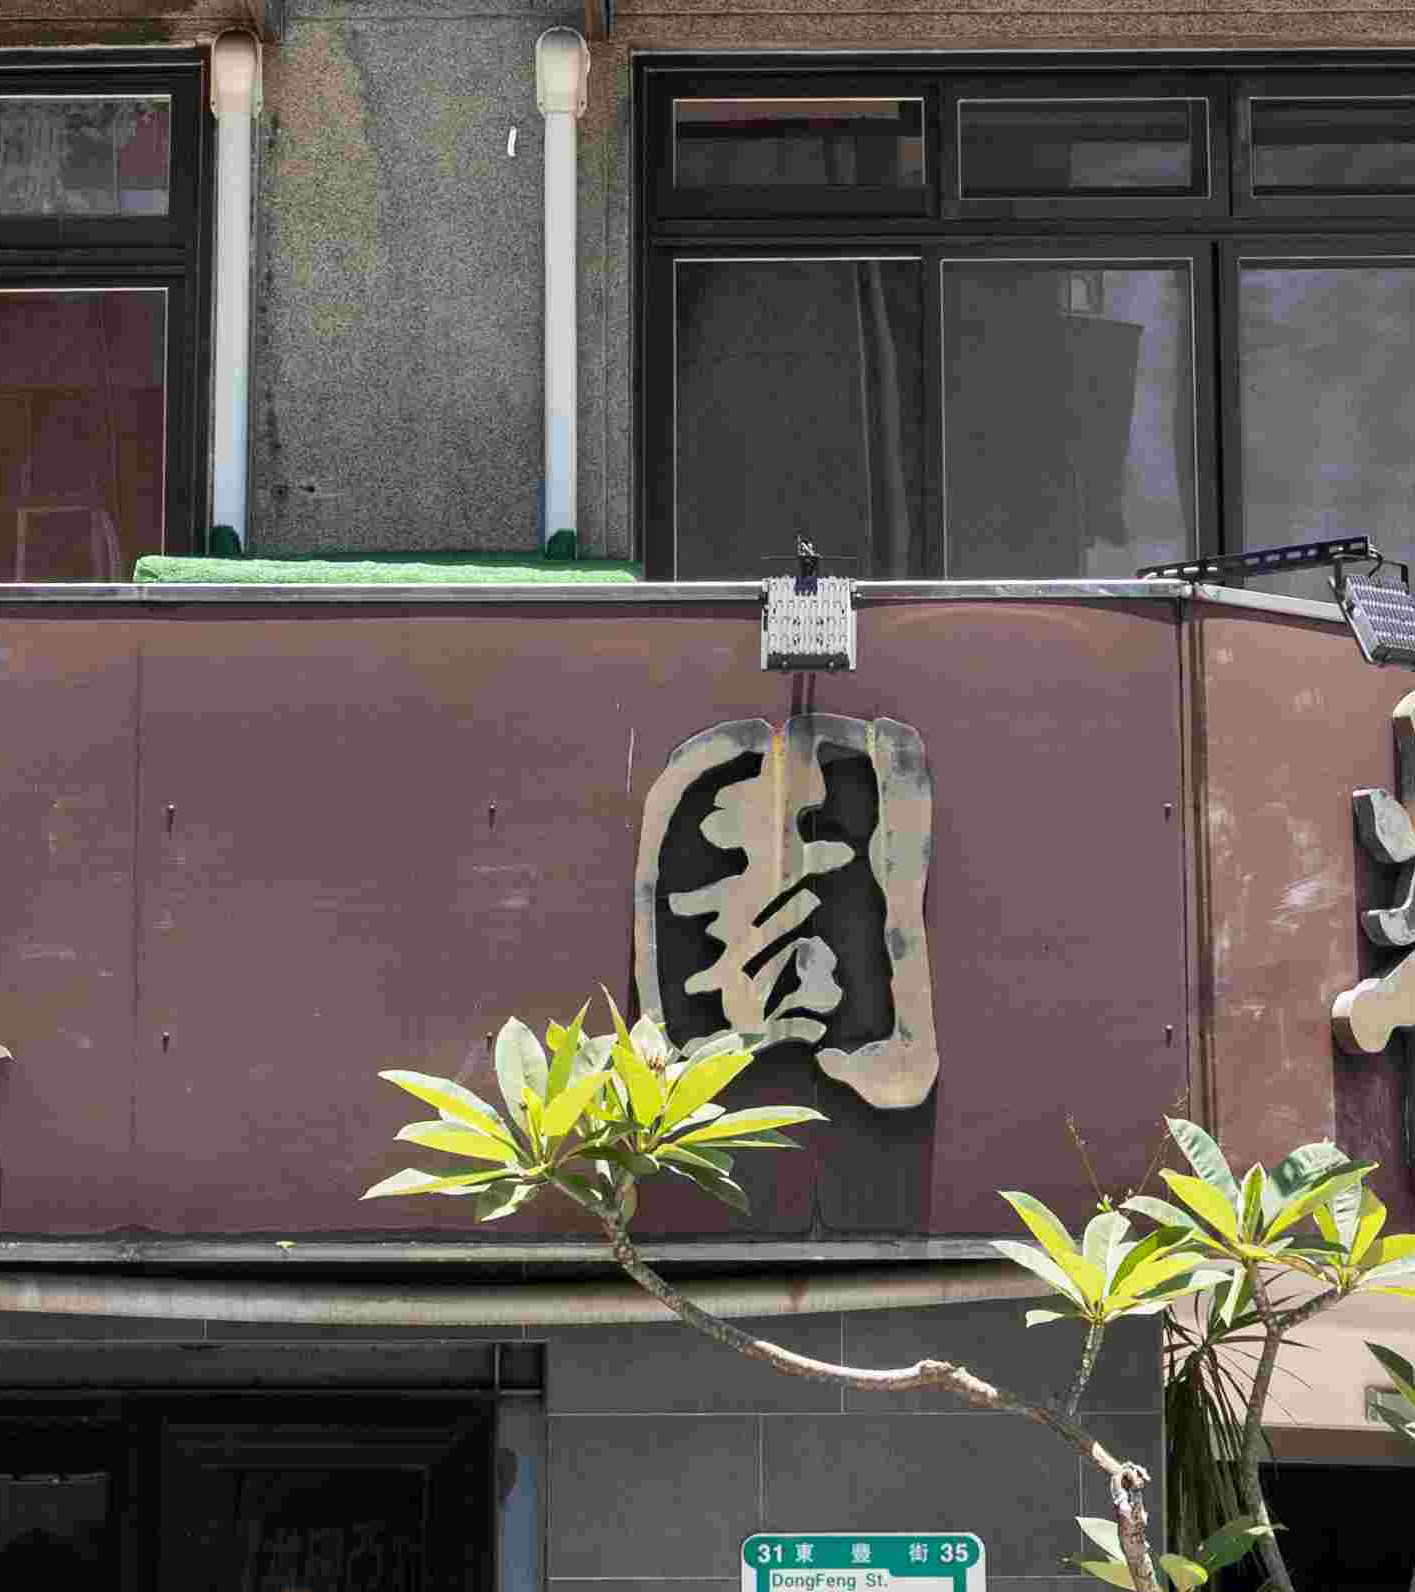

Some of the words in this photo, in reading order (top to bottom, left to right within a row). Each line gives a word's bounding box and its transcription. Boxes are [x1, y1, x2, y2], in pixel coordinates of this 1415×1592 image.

[756, 1543, 785, 1564] 31
[939, 1542, 970, 1564] 35
[771, 1573, 857, 1591] DongFeng
[865, 1573, 889, 1587] St.
